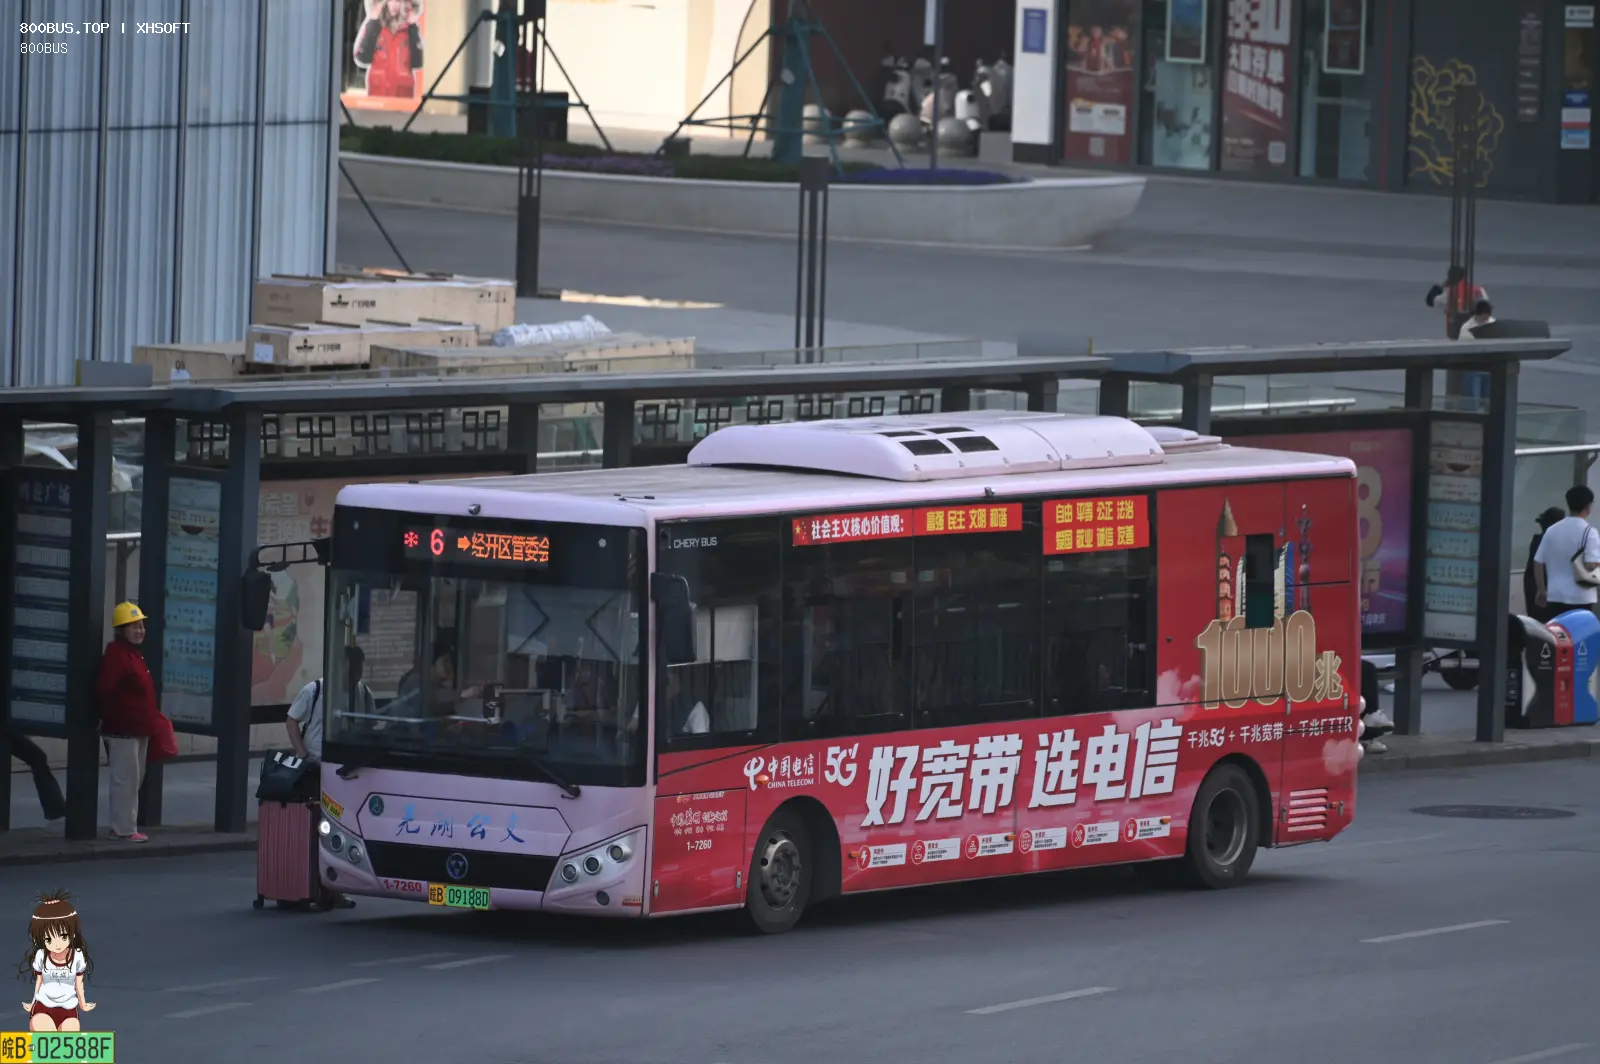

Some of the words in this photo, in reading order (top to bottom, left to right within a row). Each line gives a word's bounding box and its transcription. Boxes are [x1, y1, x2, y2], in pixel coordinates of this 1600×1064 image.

[811, 514, 905, 541] 社会主义核心价值观：
[926, 510, 945, 532] 富强
[947, 509, 966, 530] 民主
[969, 508, 986, 529] 文明
[989, 507, 1008, 528] 和谐
[1055, 503, 1073, 524] 自由
[1076, 501, 1093, 523] 平等
[1096, 501, 1114, 522] 公正
[1117, 500, 1134, 520] 法治
[429, 528, 445, 556] 6
[471, 531, 550, 563] 经开区管委会
[673, 538, 700, 549] CHERY
[701, 536, 718, 547] BUS
[1055, 529, 1073, 551] 爱国
[1076, 528, 1093, 549] 敬业
[1096, 527, 1114, 547] 诚信
[1117, 525, 1135, 546] 友善
[1239, 722, 1284, 744] 千兆宽带
[767, 753, 815, 781] 中国电信
[824, 742, 860, 788] 5G
[860, 733, 1024, 828] 好宽带
[1028, 718, 1184, 810] 选电信
[767, 780, 786, 789] CHINA
[787, 777, 814, 788] TELECOM
[686, 839, 713, 852] 1-7260
[384, 879, 423, 894] 1-7260
[448, 887, 490, 909] 09188D
